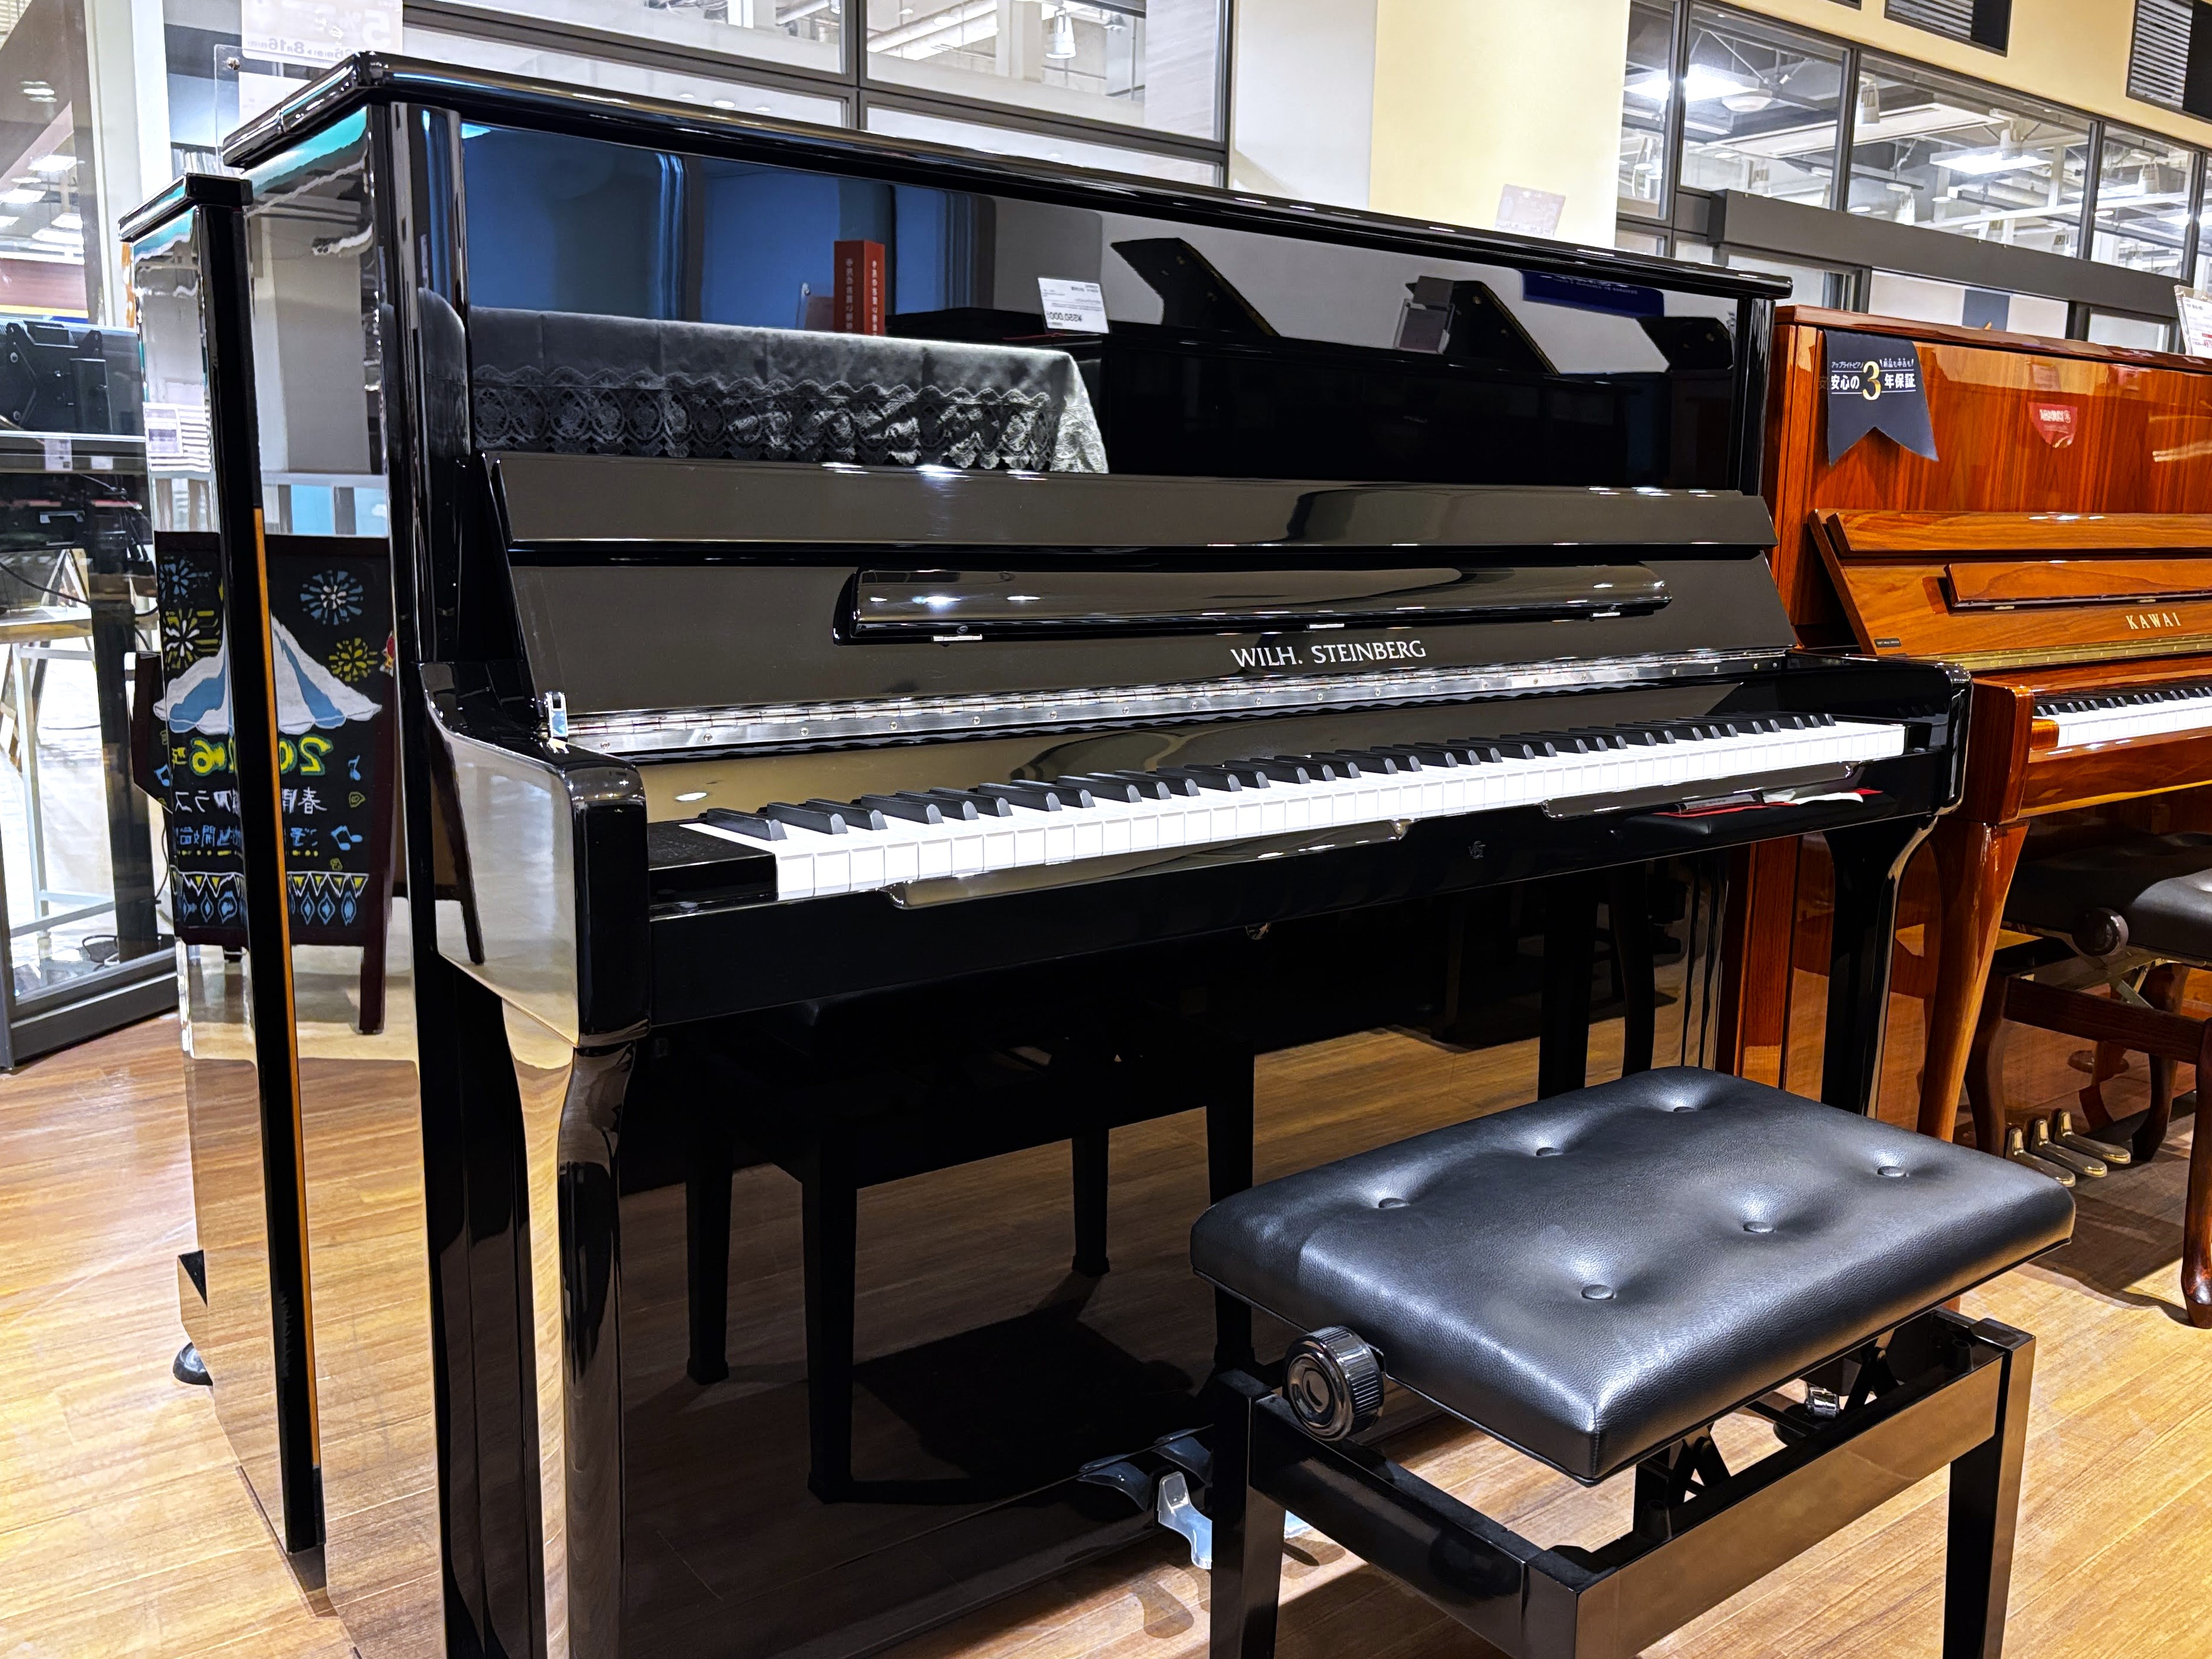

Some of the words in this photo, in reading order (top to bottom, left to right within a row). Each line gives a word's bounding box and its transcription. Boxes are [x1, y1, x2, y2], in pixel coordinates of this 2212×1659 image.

[2125, 612, 2181, 629] KAWAI
[1230, 646, 1303, 668] WILH.
[1310, 640, 1427, 664] STEINBERG
